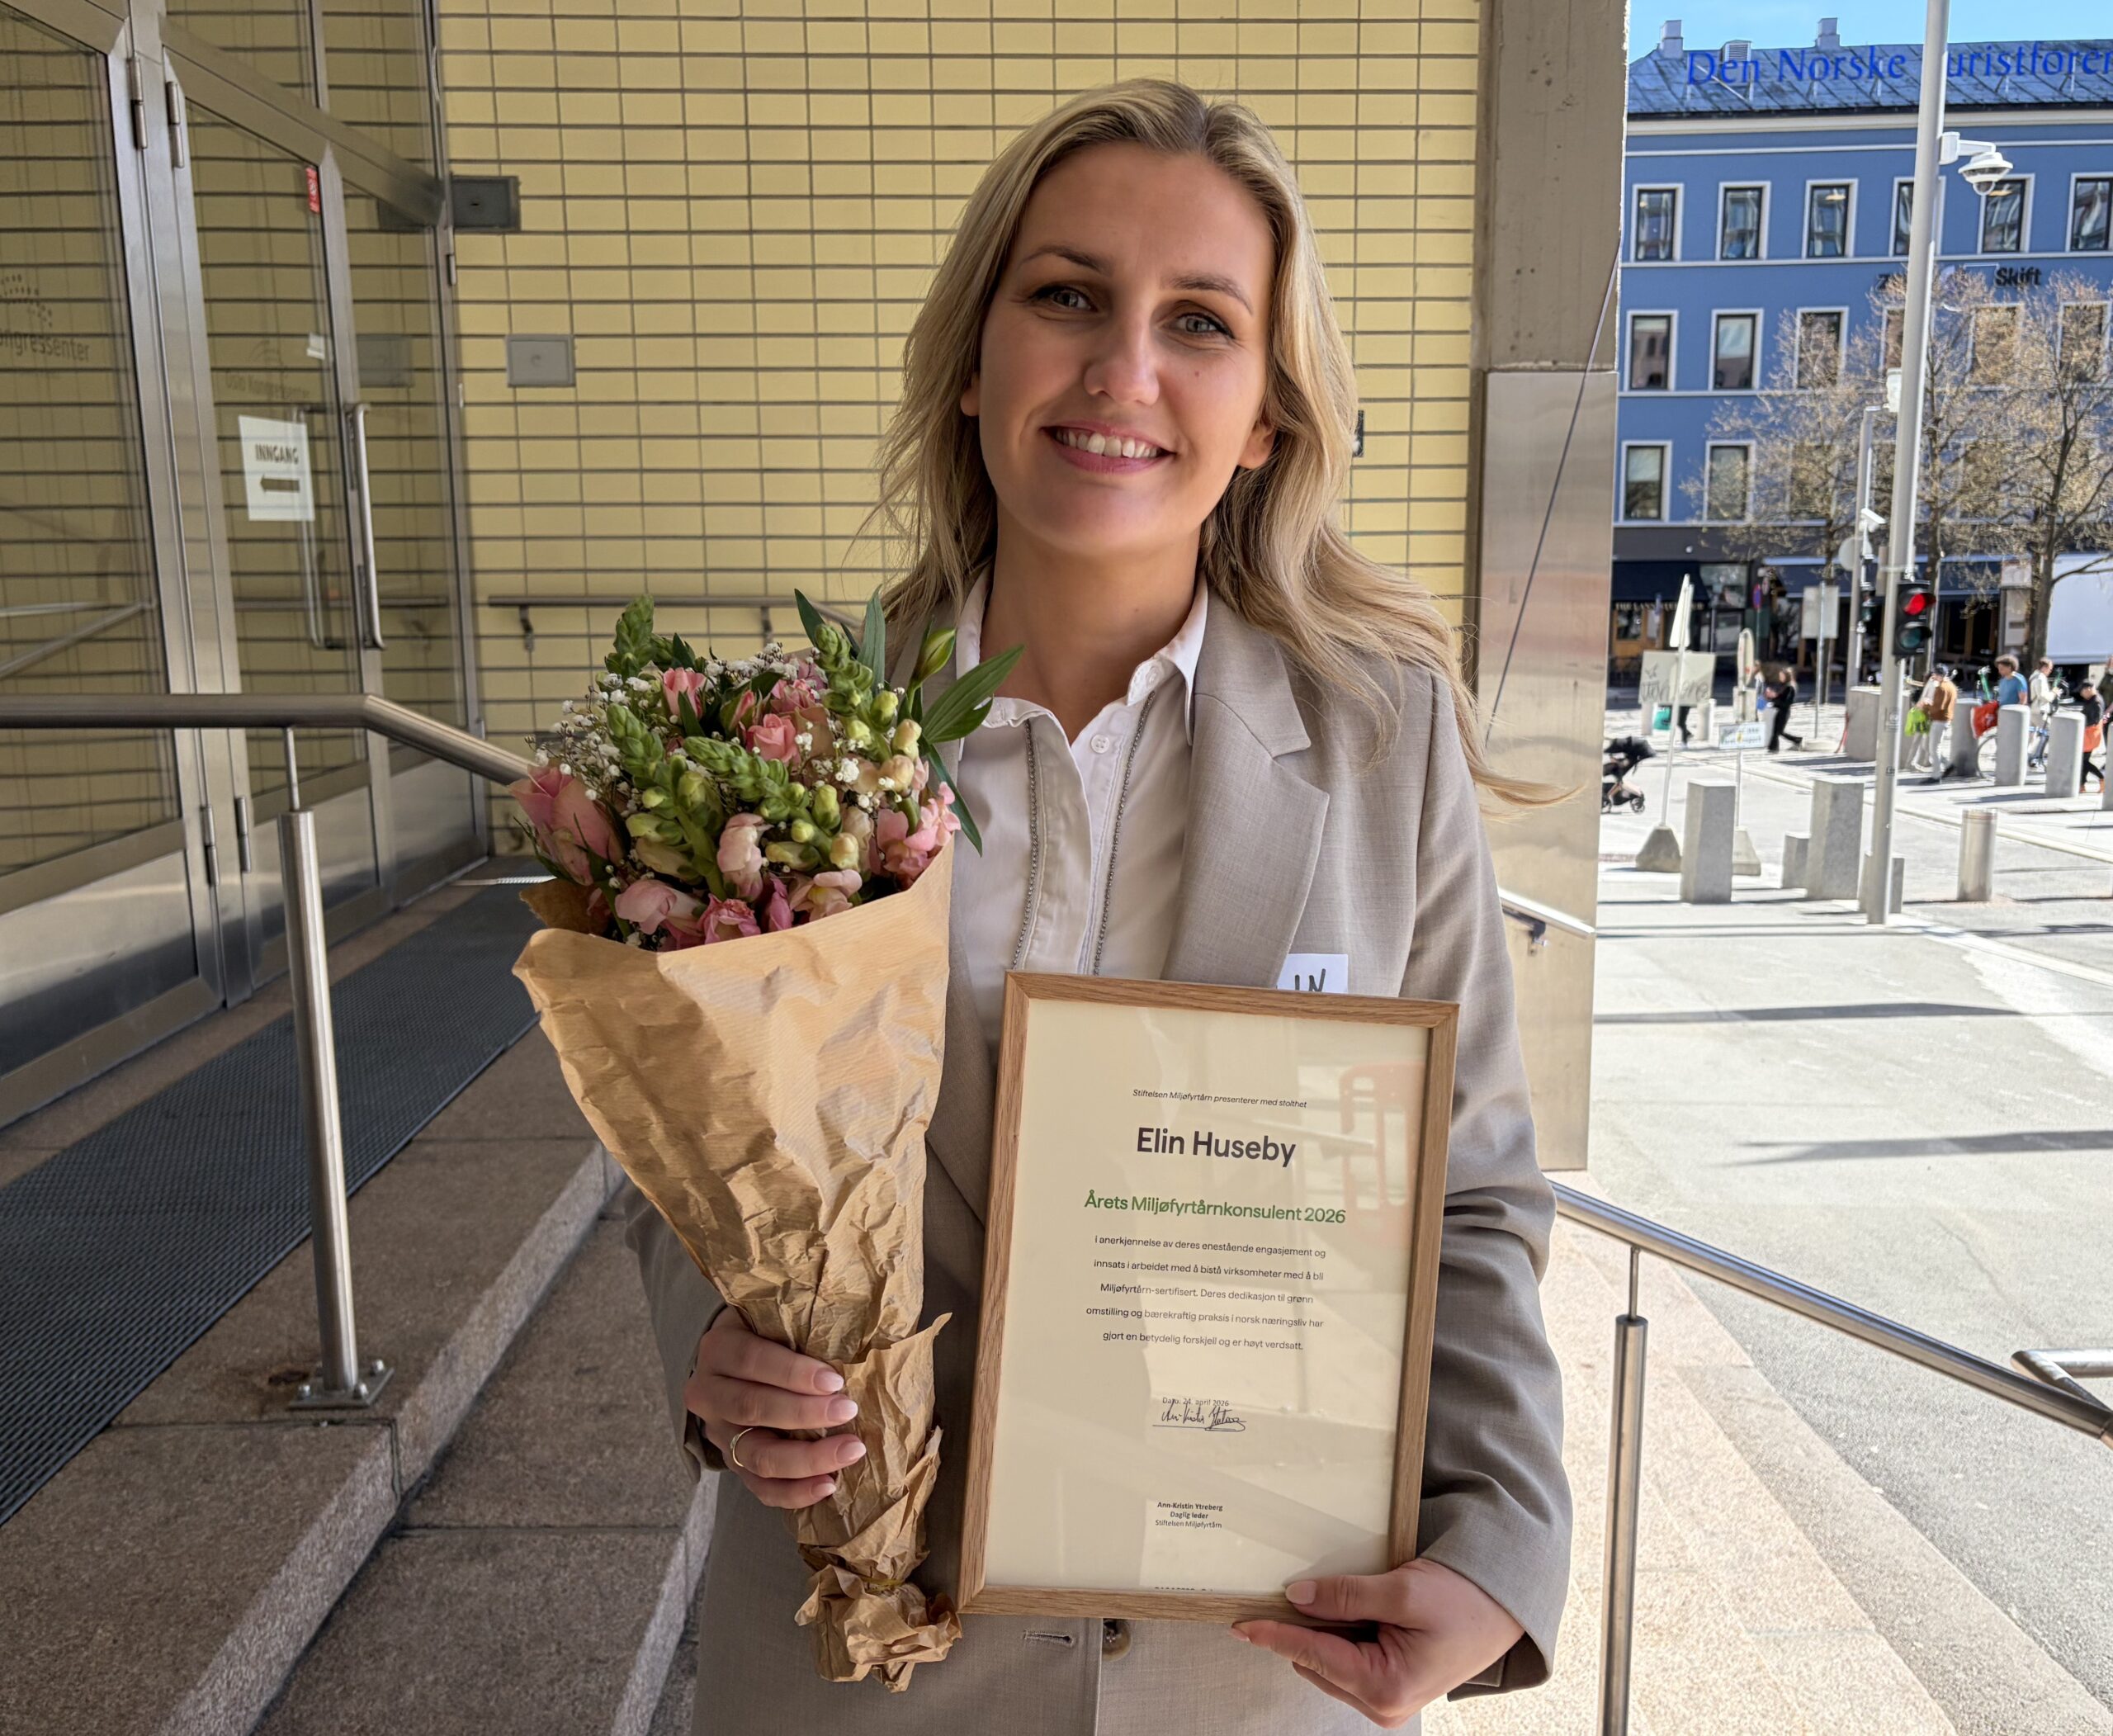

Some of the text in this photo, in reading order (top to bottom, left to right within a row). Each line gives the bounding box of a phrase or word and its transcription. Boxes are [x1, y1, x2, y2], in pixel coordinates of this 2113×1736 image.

[1688, 40, 2113, 85] Den Norske uristfore
[1996, 266, 2042, 287] Skift
[255, 443, 299, 465] INNGANG
[1132, 1089, 1307, 1109] Stiftelsen Miljøfyrtårn presenterer med stolthet
[1137, 1128, 1296, 1167] Elin Huseby
[1085, 1190, 1346, 1223] Årets Miljøfyrtårnkonsulent 2026
[1099, 1236, 1162, 1247] anerkjennelse
[1175, 1240, 1201, 1250] deres
[1201, 1242, 1255, 1253] enestående
[1255, 1246, 1312, 1257] engasjement
[1314, 1250, 1326, 1260] og
[1094, 1259, 1126, 1270] innsats
[1131, 1261, 1170, 1272] arbeidet
[1170, 1264, 1192, 1273] med
[1199, 1265, 1222, 1275] bistå
[1223, 1267, 1283, 1278] virksomheter
[1283, 1270, 1304, 1280] med
[1312, 1271, 1324, 1281] bli
[1100, 1283, 1313, 1304] Miljøfyrtårn-sertifisert. Deres dedikasjon til grønn
[1085, 1307, 1130, 1319] omstilling
[1130, 1310, 1143, 1319] og
[1144, 1309, 1197, 1322] bærekraftig
[1198, 1313, 1230, 1322] praksis
[1235, 1315, 1260, 1324] norsk
[1261, 1317, 1307, 1328] næringsliv
[1308, 1318, 1325, 1327] har
[1103, 1331, 1125, 1341] gjort
[1125, 1333, 1137, 1341] en
[1139, 1332, 1181, 1346] betydelig
[1183, 1334, 1217, 1346] forskjell
[1218, 1338, 1231, 1348] og
[1243, 1337, 1264, 1350] høyt
[1264, 1341, 1304, 1351] verdsatt.
[1157, 1502, 1223, 1512] Ann-Kristin Ytreberg
[1170, 1511, 1208, 1520] Daglig leder
[1155, 1519, 1222, 1530] Stiftelsen Miljøfyrtårn
